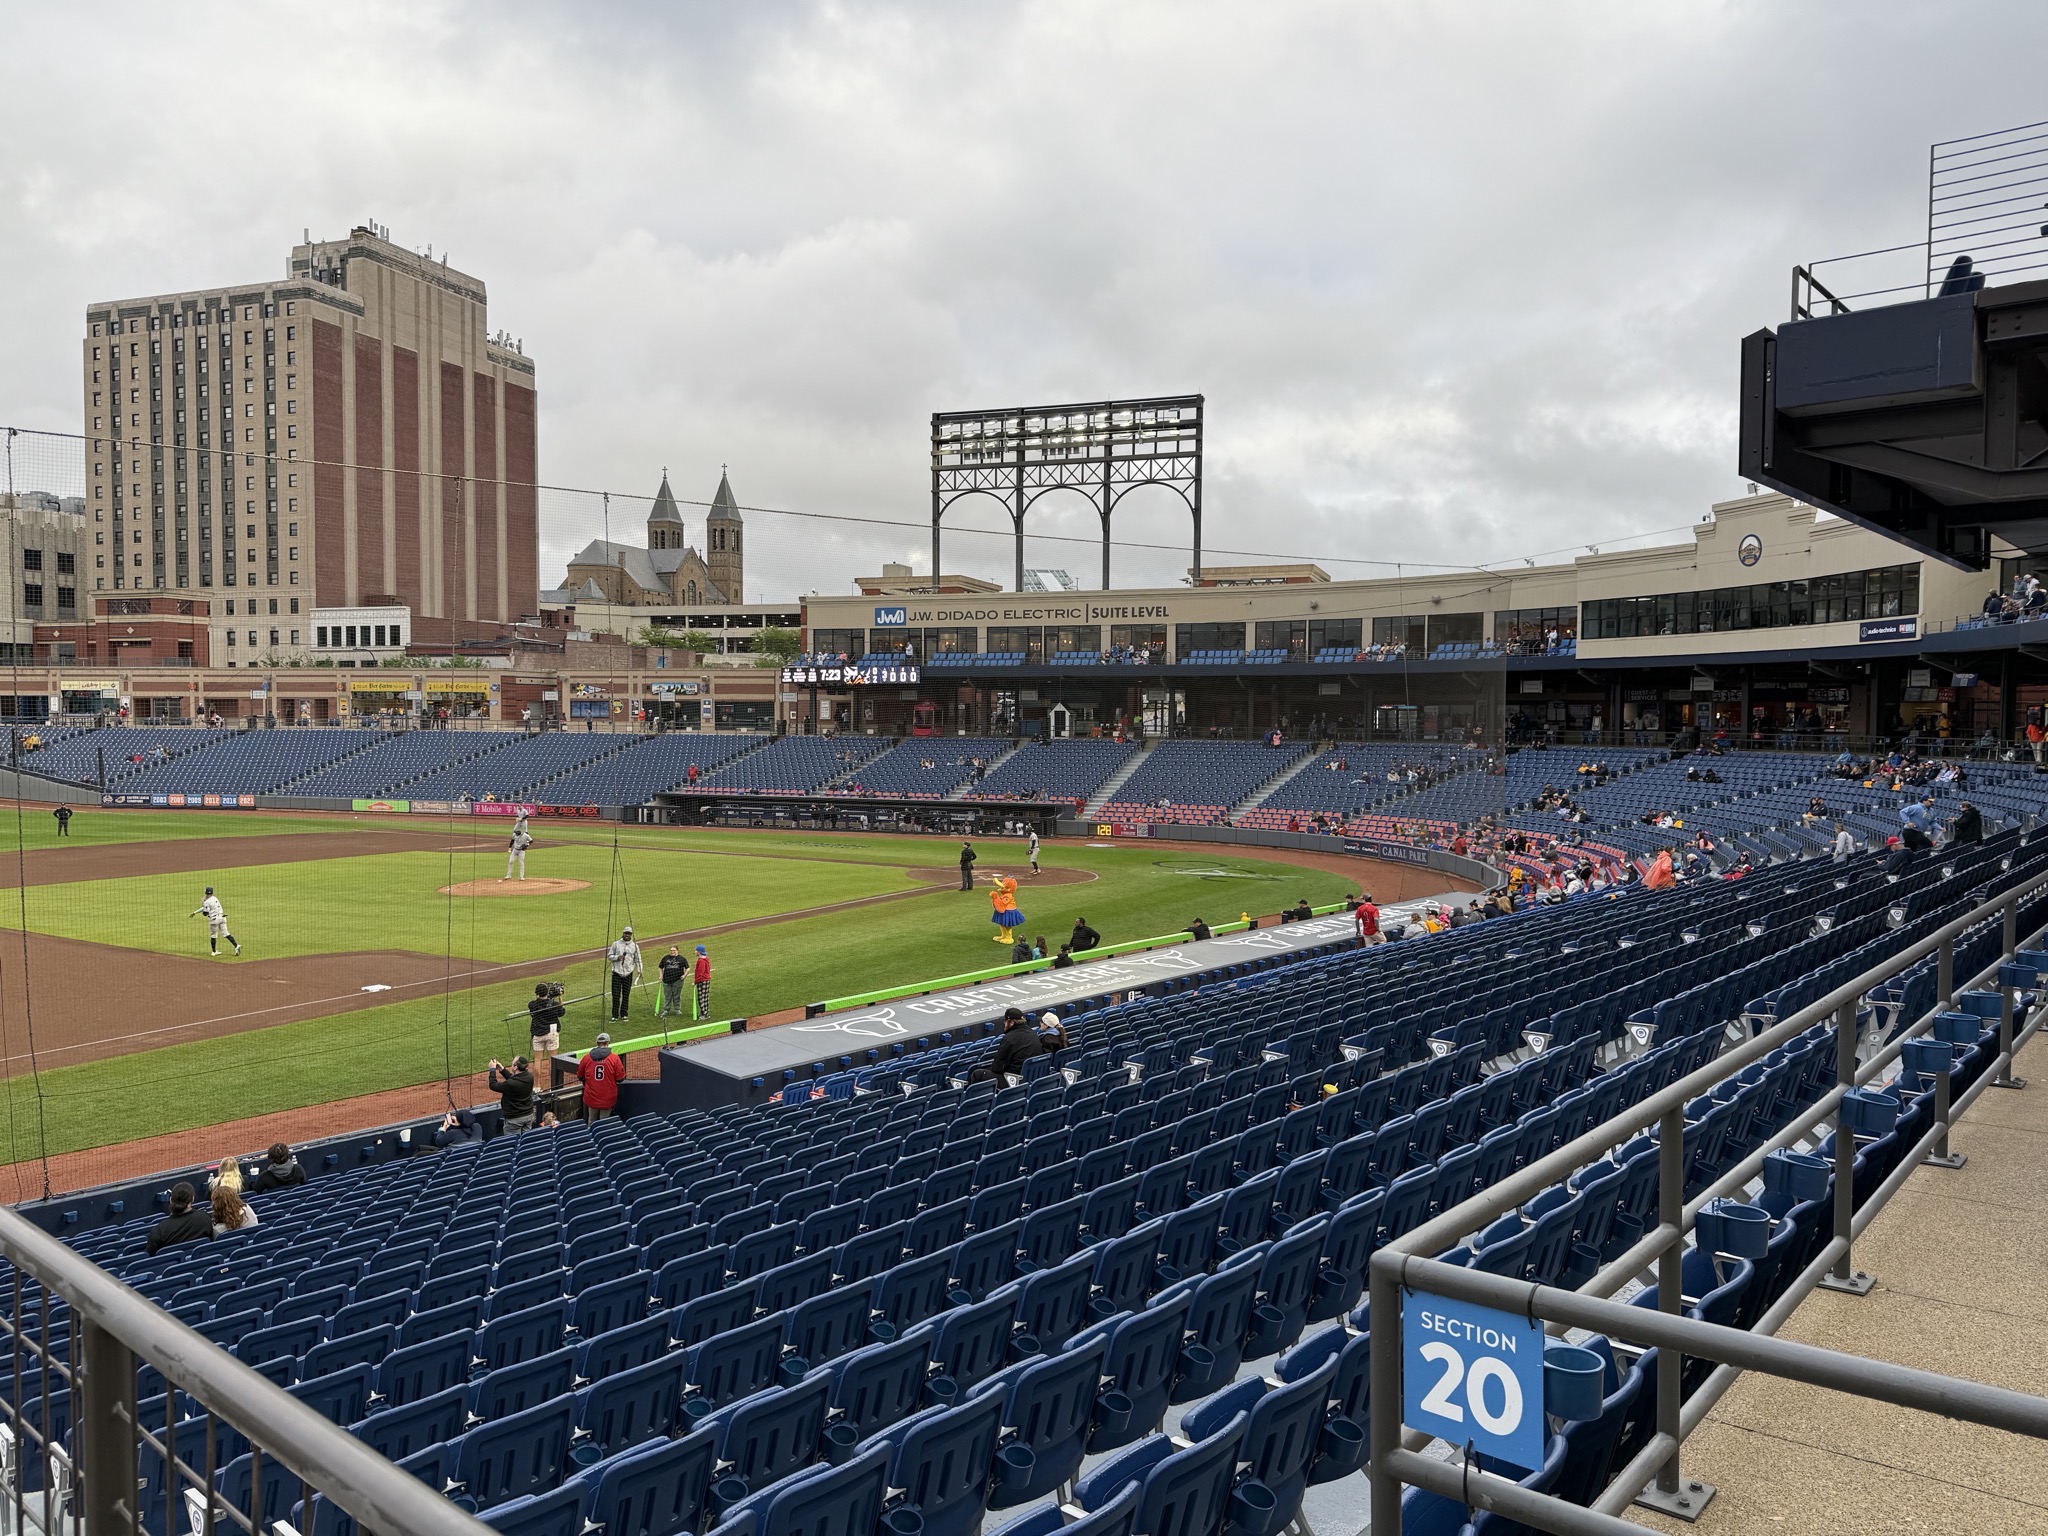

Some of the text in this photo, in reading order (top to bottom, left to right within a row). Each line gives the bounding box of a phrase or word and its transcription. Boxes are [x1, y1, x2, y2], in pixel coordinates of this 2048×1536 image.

[908, 608, 1082, 622] J.W. DIDADO ELECTRIC
[1091, 606, 1170, 619] SUITE LEVEL
[820, 669, 841, 681] 7:23
[481, 804, 502, 813] Mobile
[1097, 825, 1112, 836] 128
[1382, 846, 1427, 863] CANAL PARK
[1273, 919, 1354, 937] CRAFTY
[905, 964, 1134, 1015] CRAFTY STEERE
[595, 1065, 605, 1081] 6
[1421, 1311, 1517, 1354] SECTION
[1419, 1341, 1524, 1437] 20
